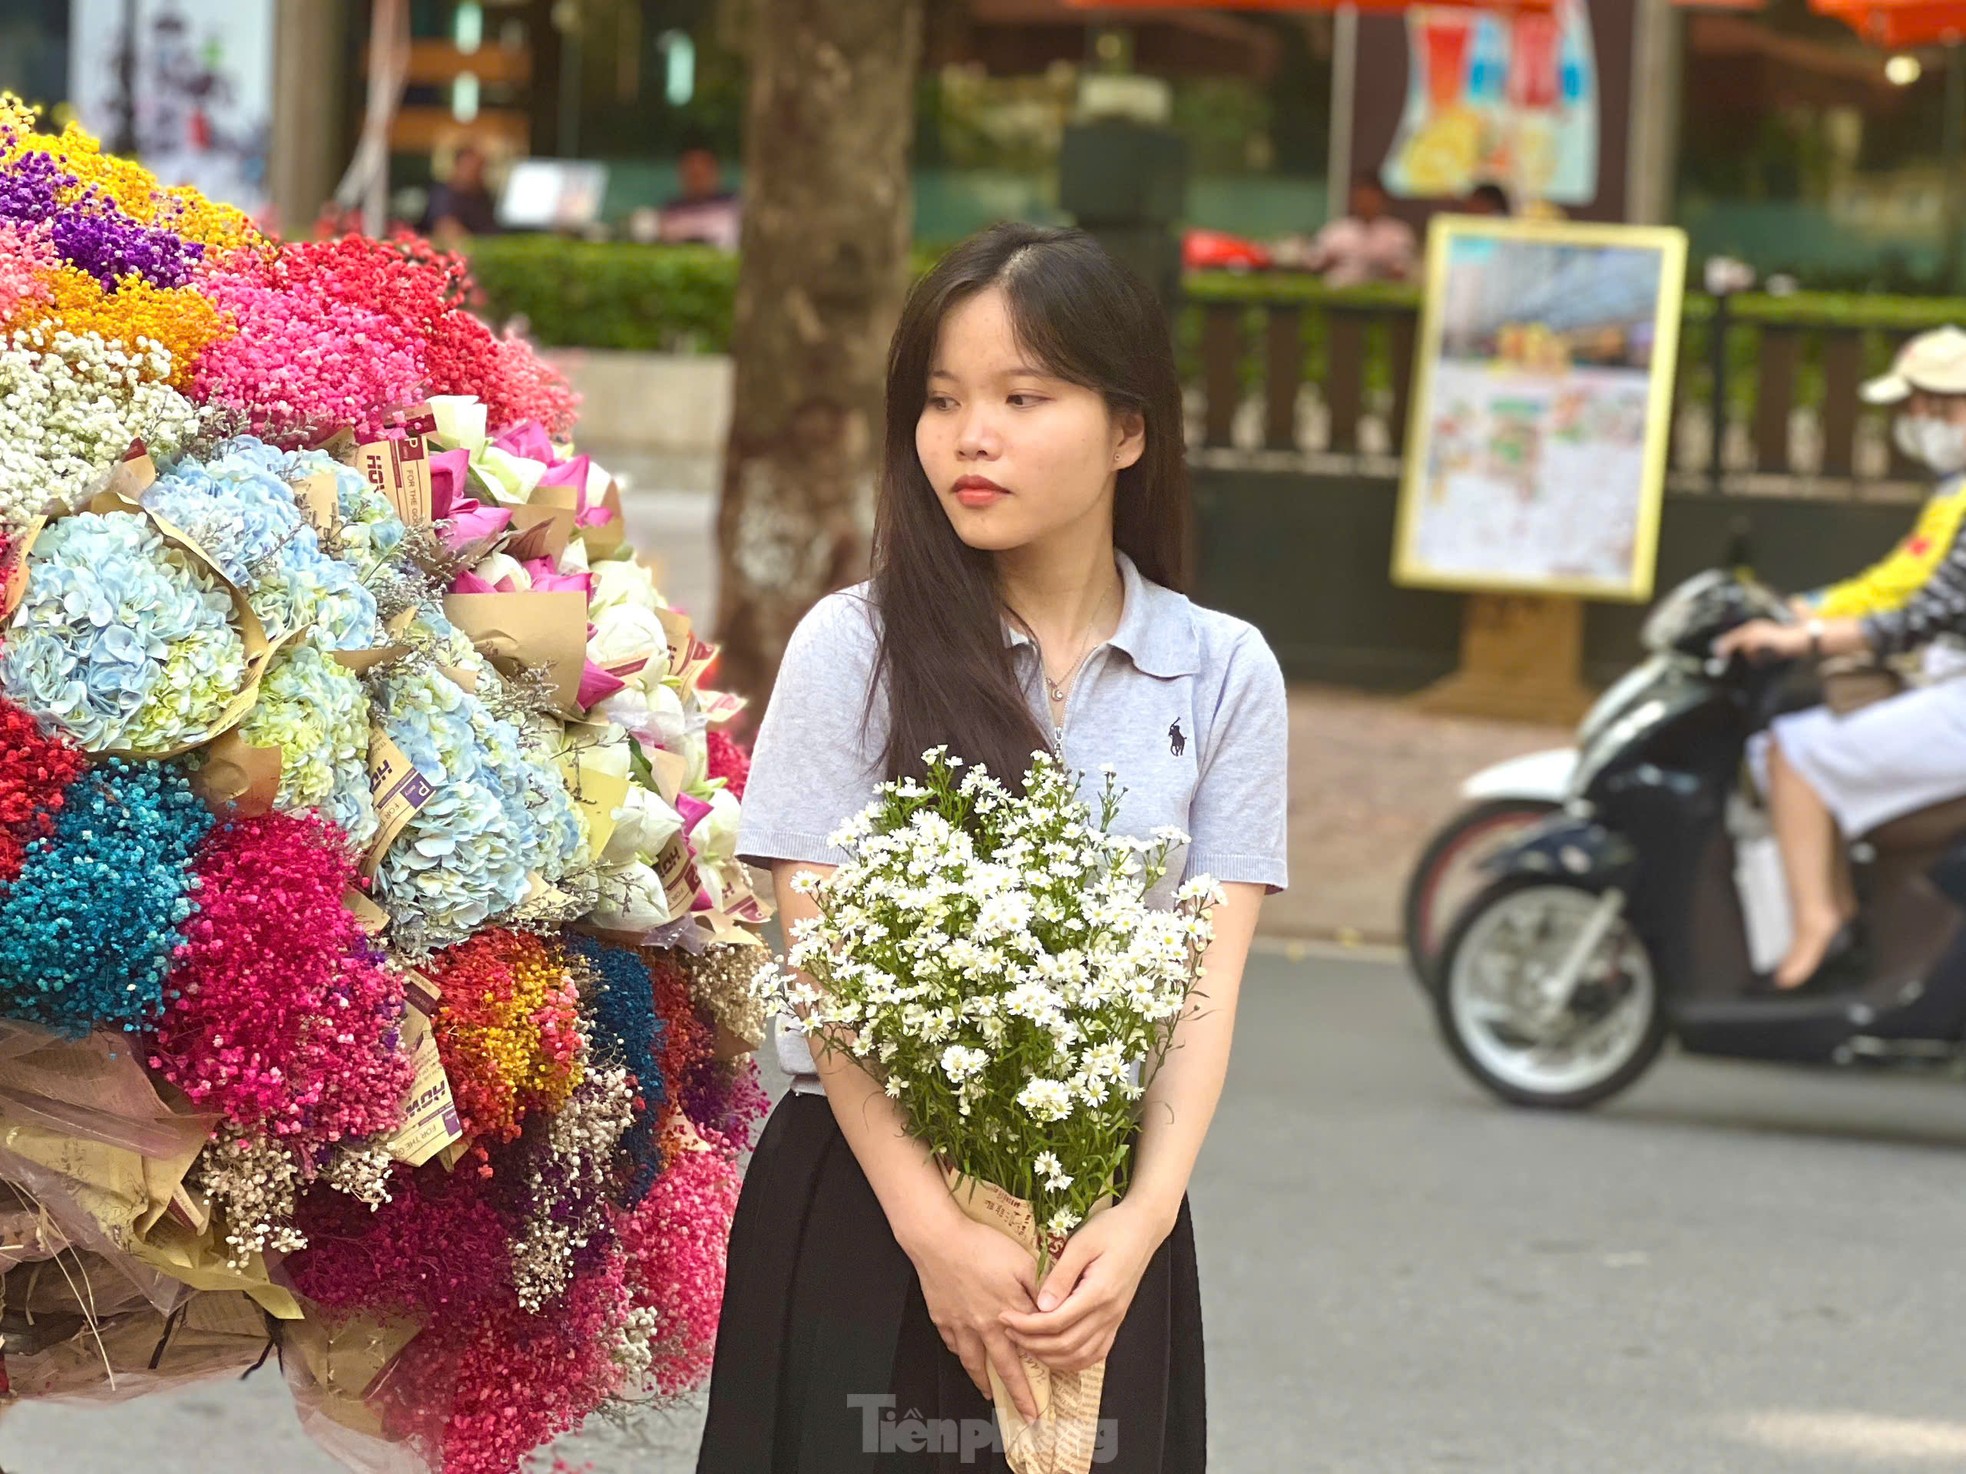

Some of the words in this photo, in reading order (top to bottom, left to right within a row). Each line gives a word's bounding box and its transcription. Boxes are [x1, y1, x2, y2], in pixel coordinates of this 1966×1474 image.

[406, 469, 416, 488] FOR
[410, 489, 418, 506] THE
[411, 507, 421, 529] GOO
[369, 759, 393, 793] HO
[384, 802, 401, 819] FOR
[421, 1123, 437, 1140] FOR
[405, 1134, 421, 1150] THE
